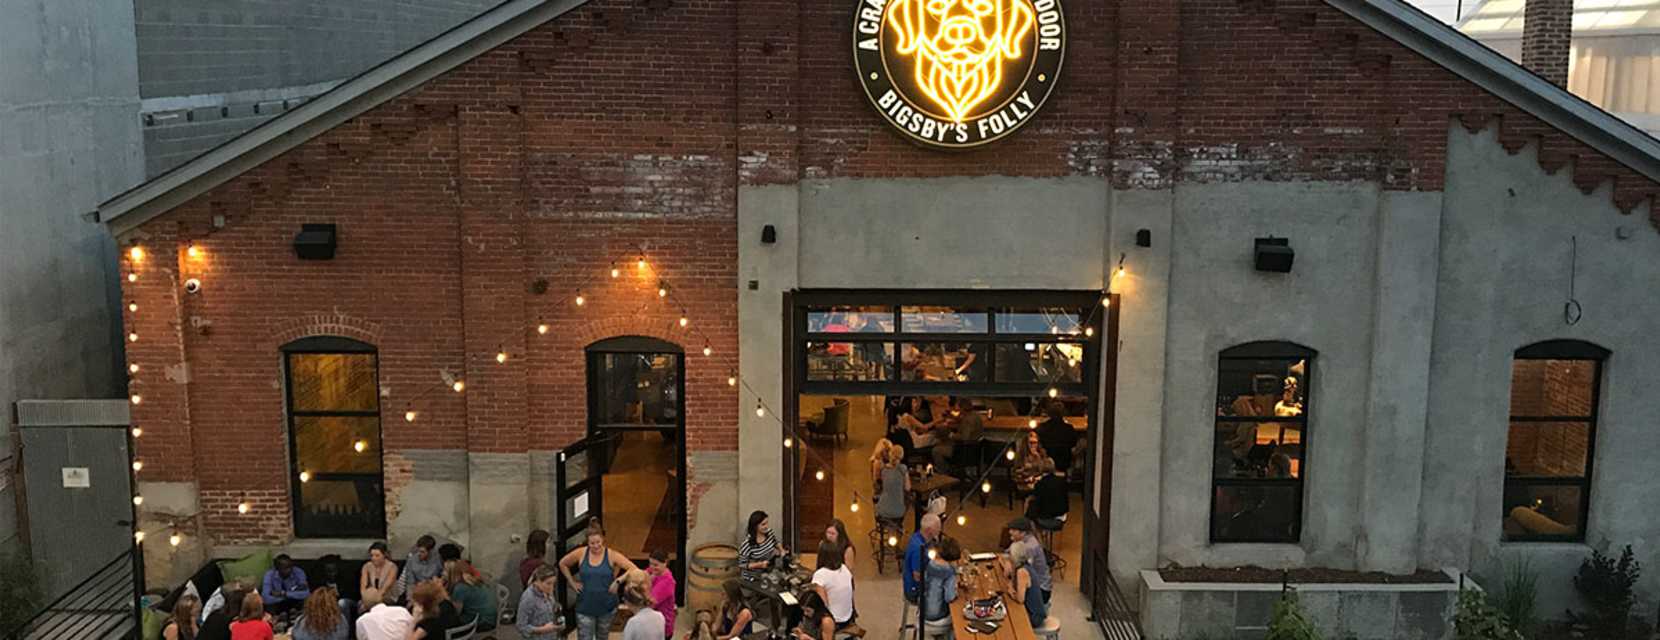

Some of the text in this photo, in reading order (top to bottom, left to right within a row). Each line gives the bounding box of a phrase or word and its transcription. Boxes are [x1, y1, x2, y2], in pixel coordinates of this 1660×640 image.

[859, 38, 879, 51] A
[1034, 0, 1061, 50] DOOR
[878, 89, 1036, 142] BIGSBY'S FOLLY
